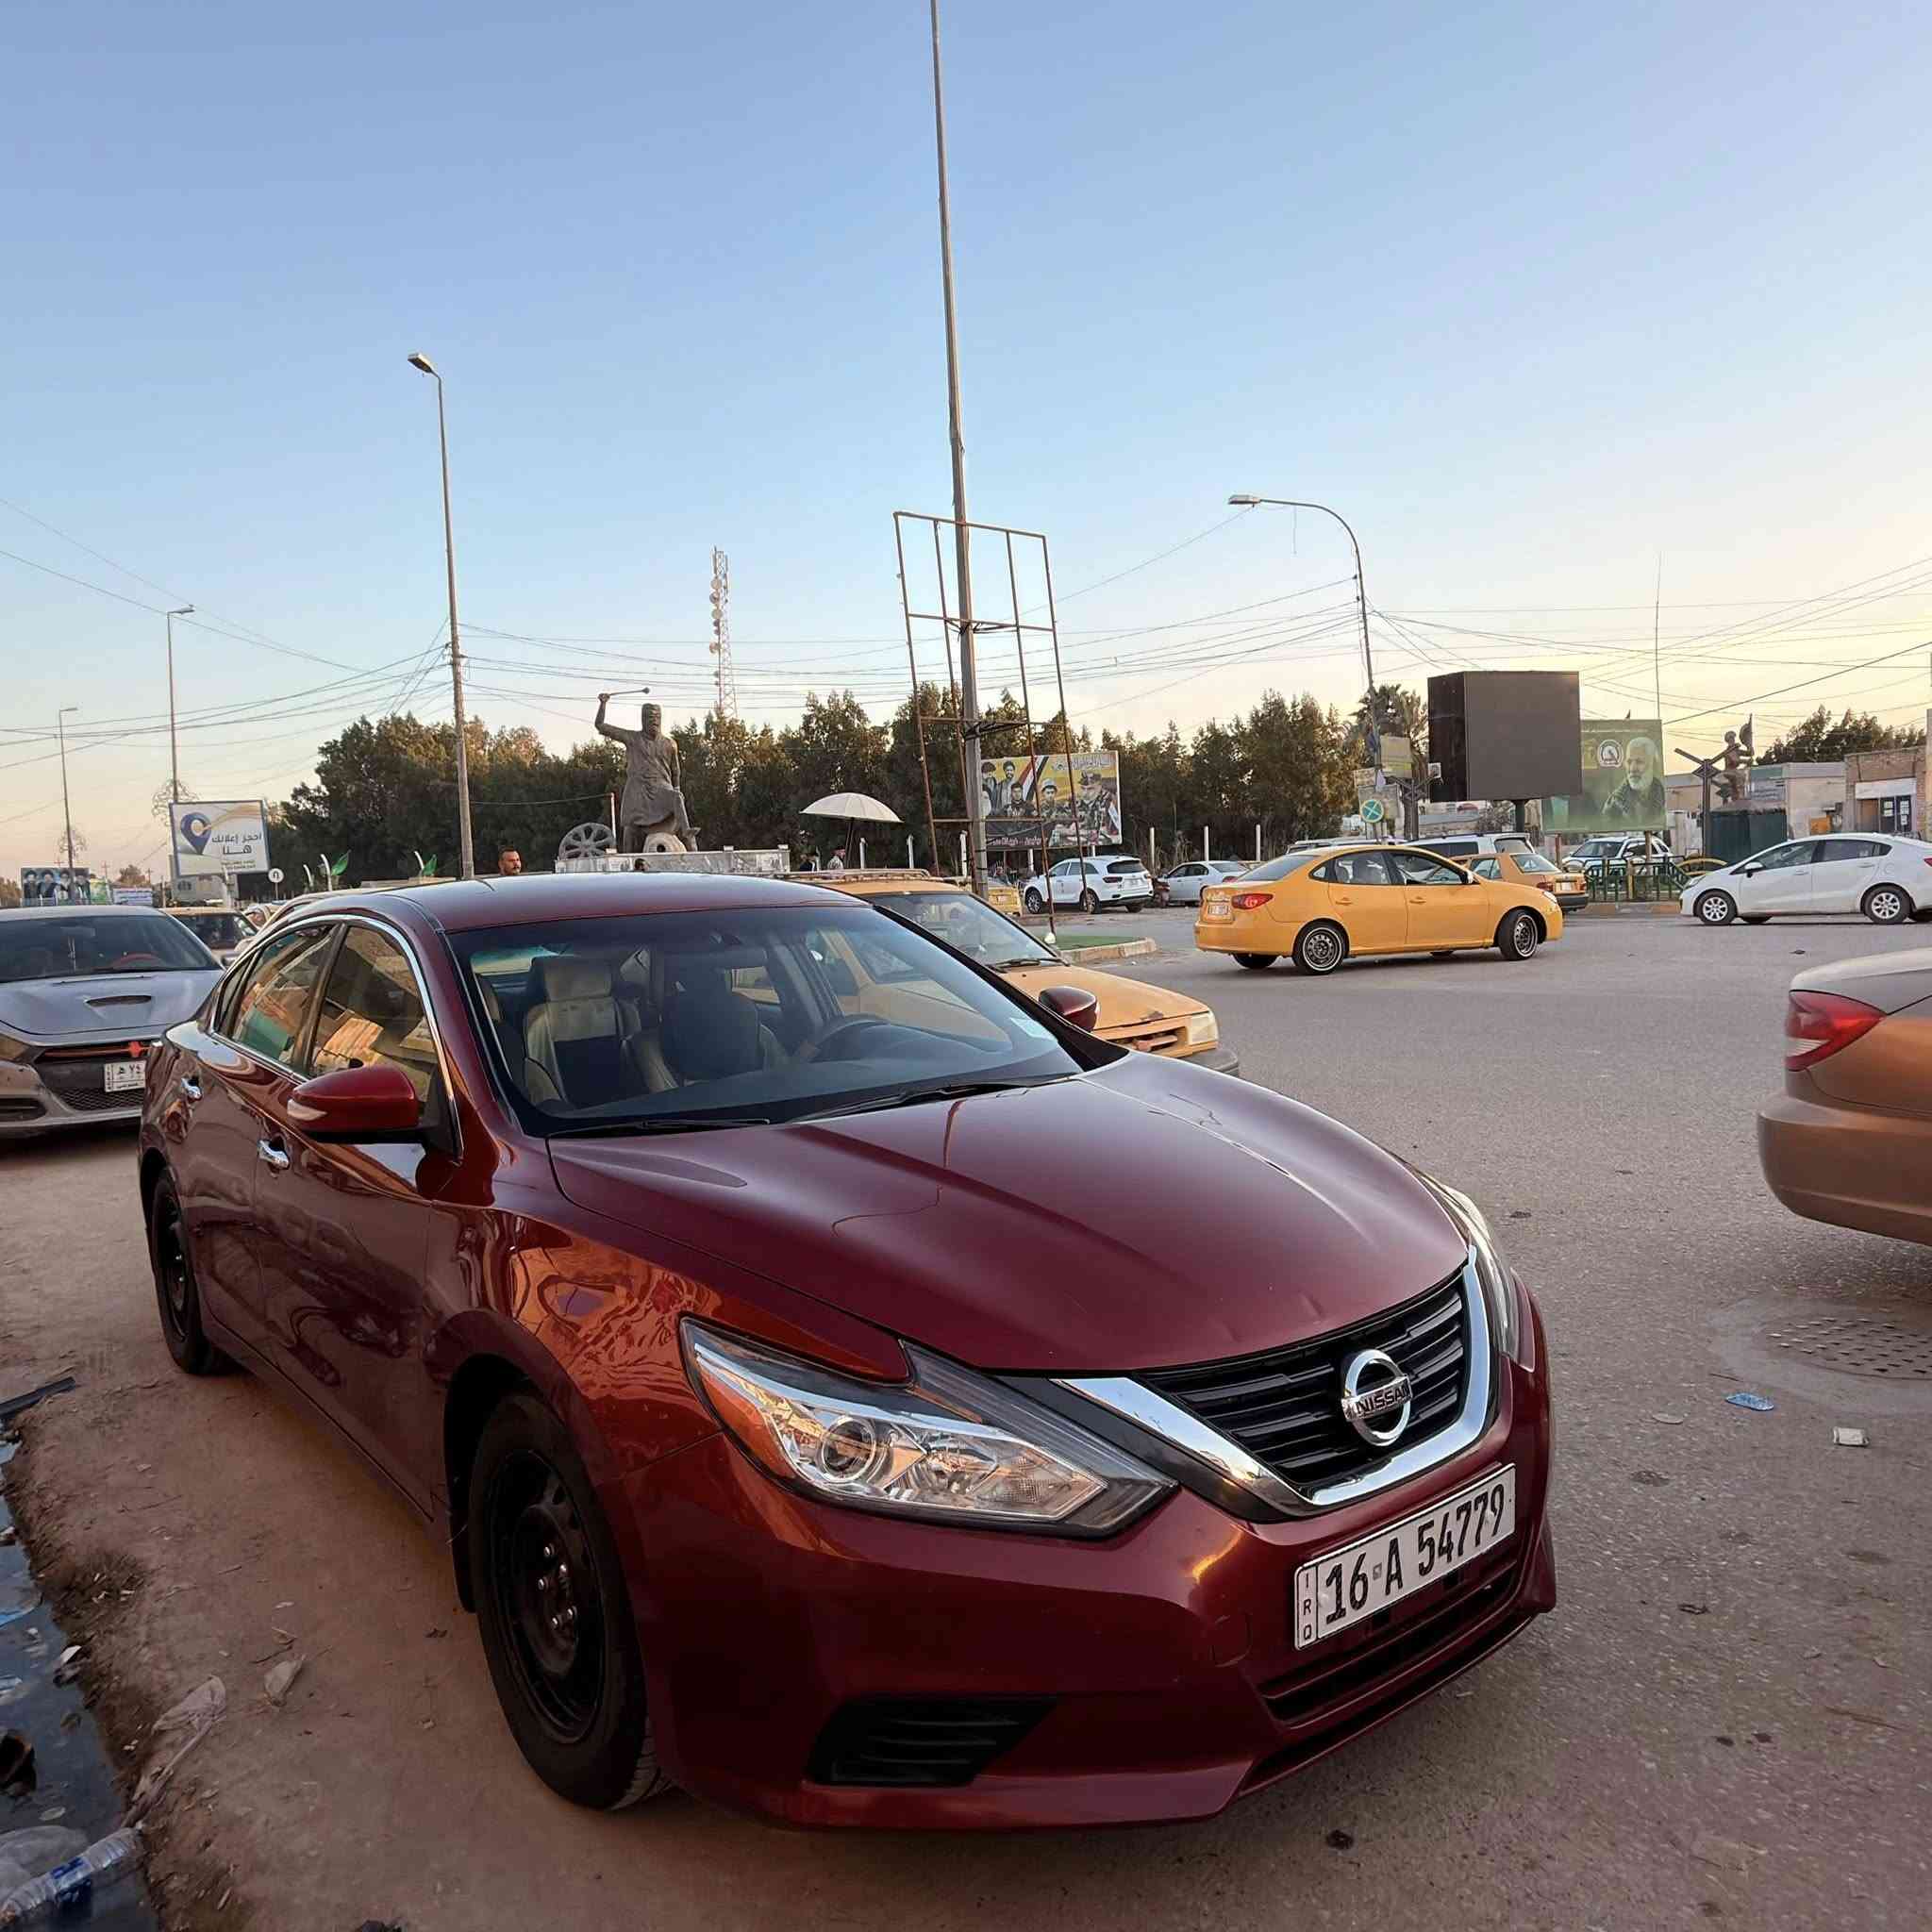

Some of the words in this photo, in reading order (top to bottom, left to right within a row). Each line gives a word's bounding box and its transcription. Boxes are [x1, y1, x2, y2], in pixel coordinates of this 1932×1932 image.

[1325, 1553, 1369, 1624] 16
[1385, 1537, 1404, 1596] A
[1417, 1483, 1505, 1577] 54779
